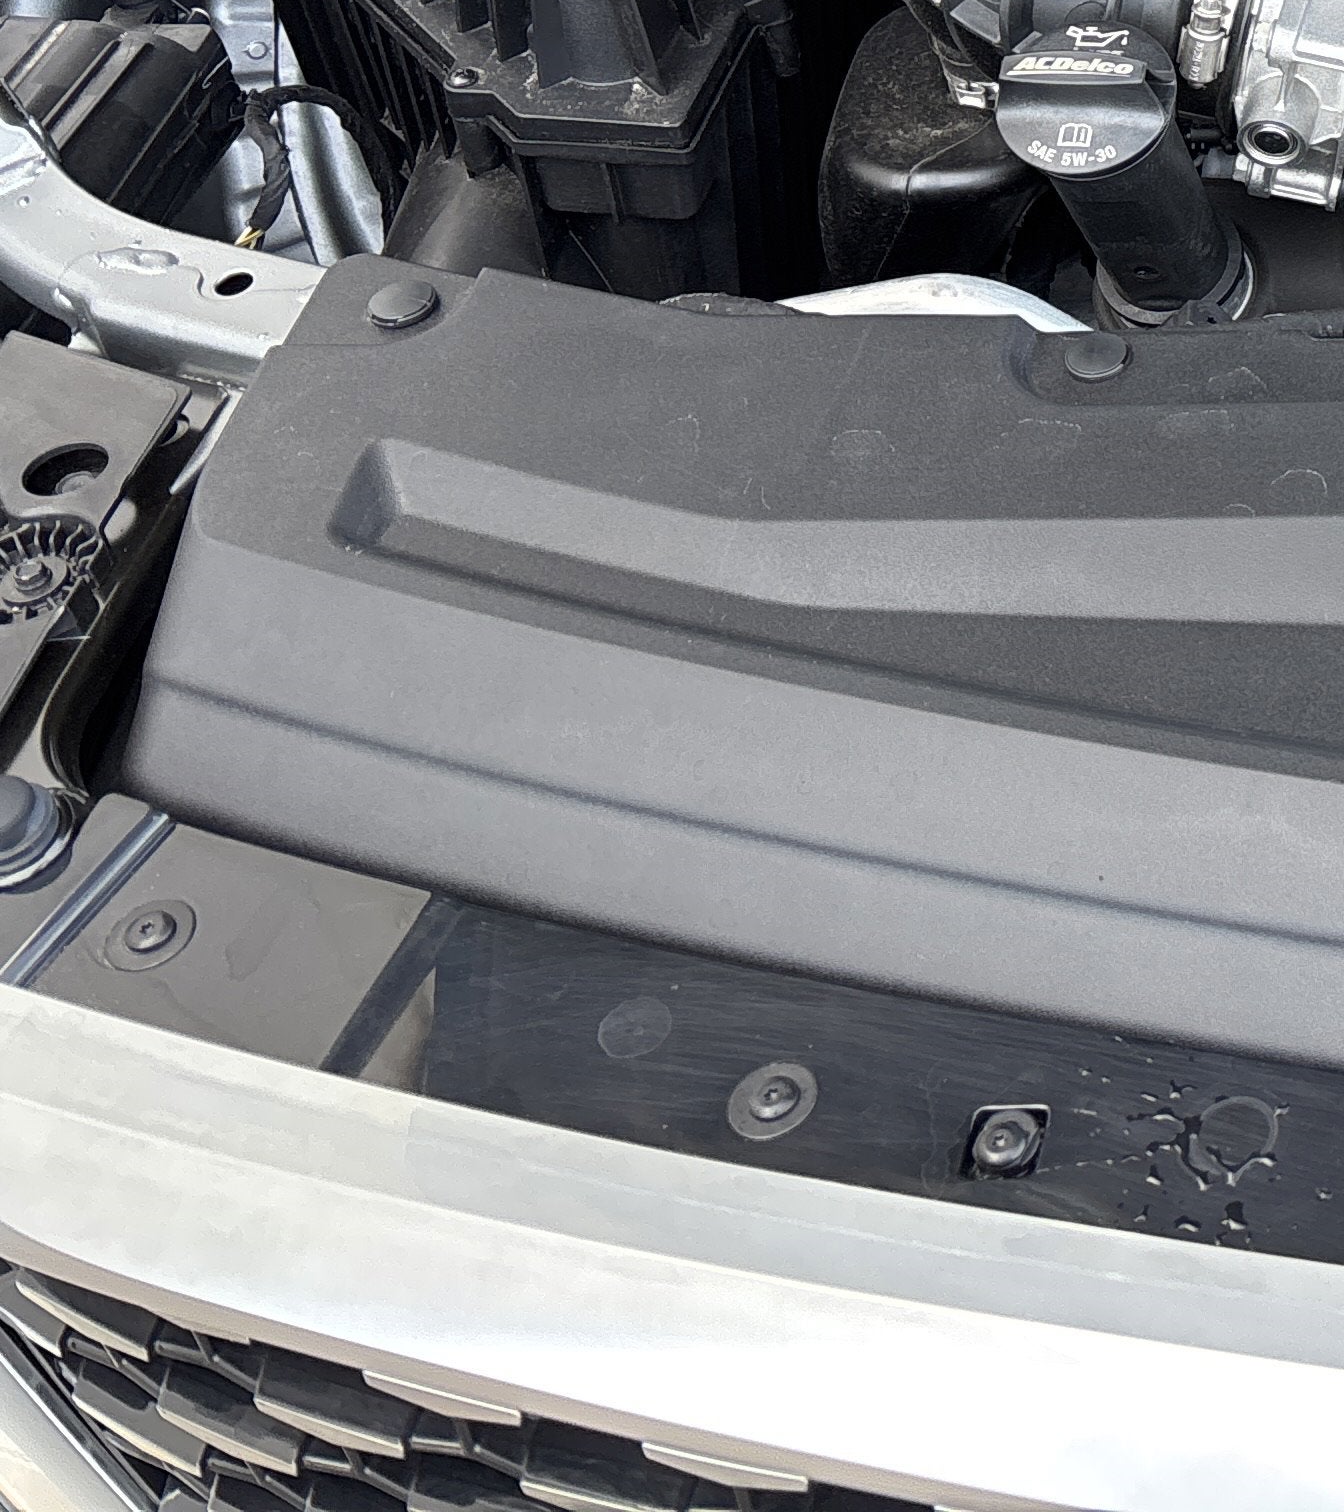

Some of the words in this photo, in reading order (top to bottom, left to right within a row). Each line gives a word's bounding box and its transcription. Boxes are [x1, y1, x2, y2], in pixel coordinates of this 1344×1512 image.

[1013, 56, 1134, 75] ACDelco
[1027, 140, 1057, 163] SAE
[1060, 144, 1117, 167] 5W-30
